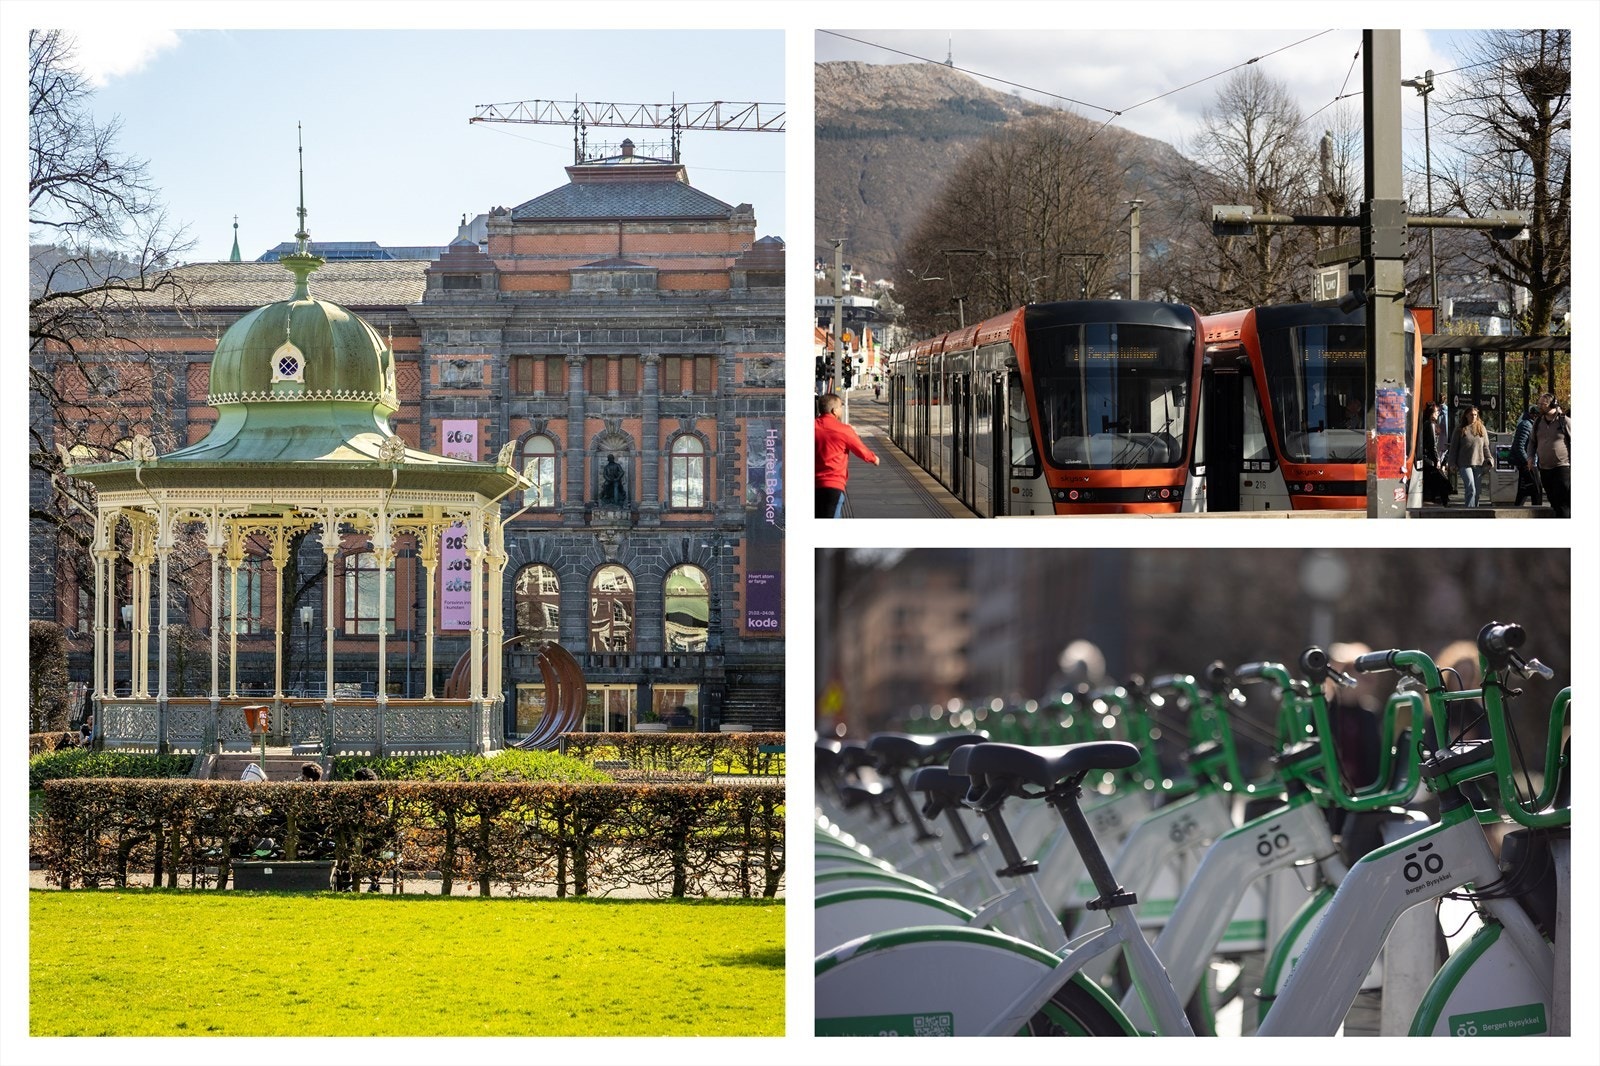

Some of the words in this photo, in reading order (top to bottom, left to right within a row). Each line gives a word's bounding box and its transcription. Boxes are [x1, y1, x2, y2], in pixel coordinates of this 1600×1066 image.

[765, 429, 778, 476] Harriet
[765, 478, 778, 525] Backer
[748, 618, 778, 628] kode
[1405, 884, 1426, 895] Bergen
[1426, 872, 1452, 887] Bysykkel
[1482, 1023, 1507, 1031] Bergen
[1508, 1016, 1540, 1028] Bysykkel
